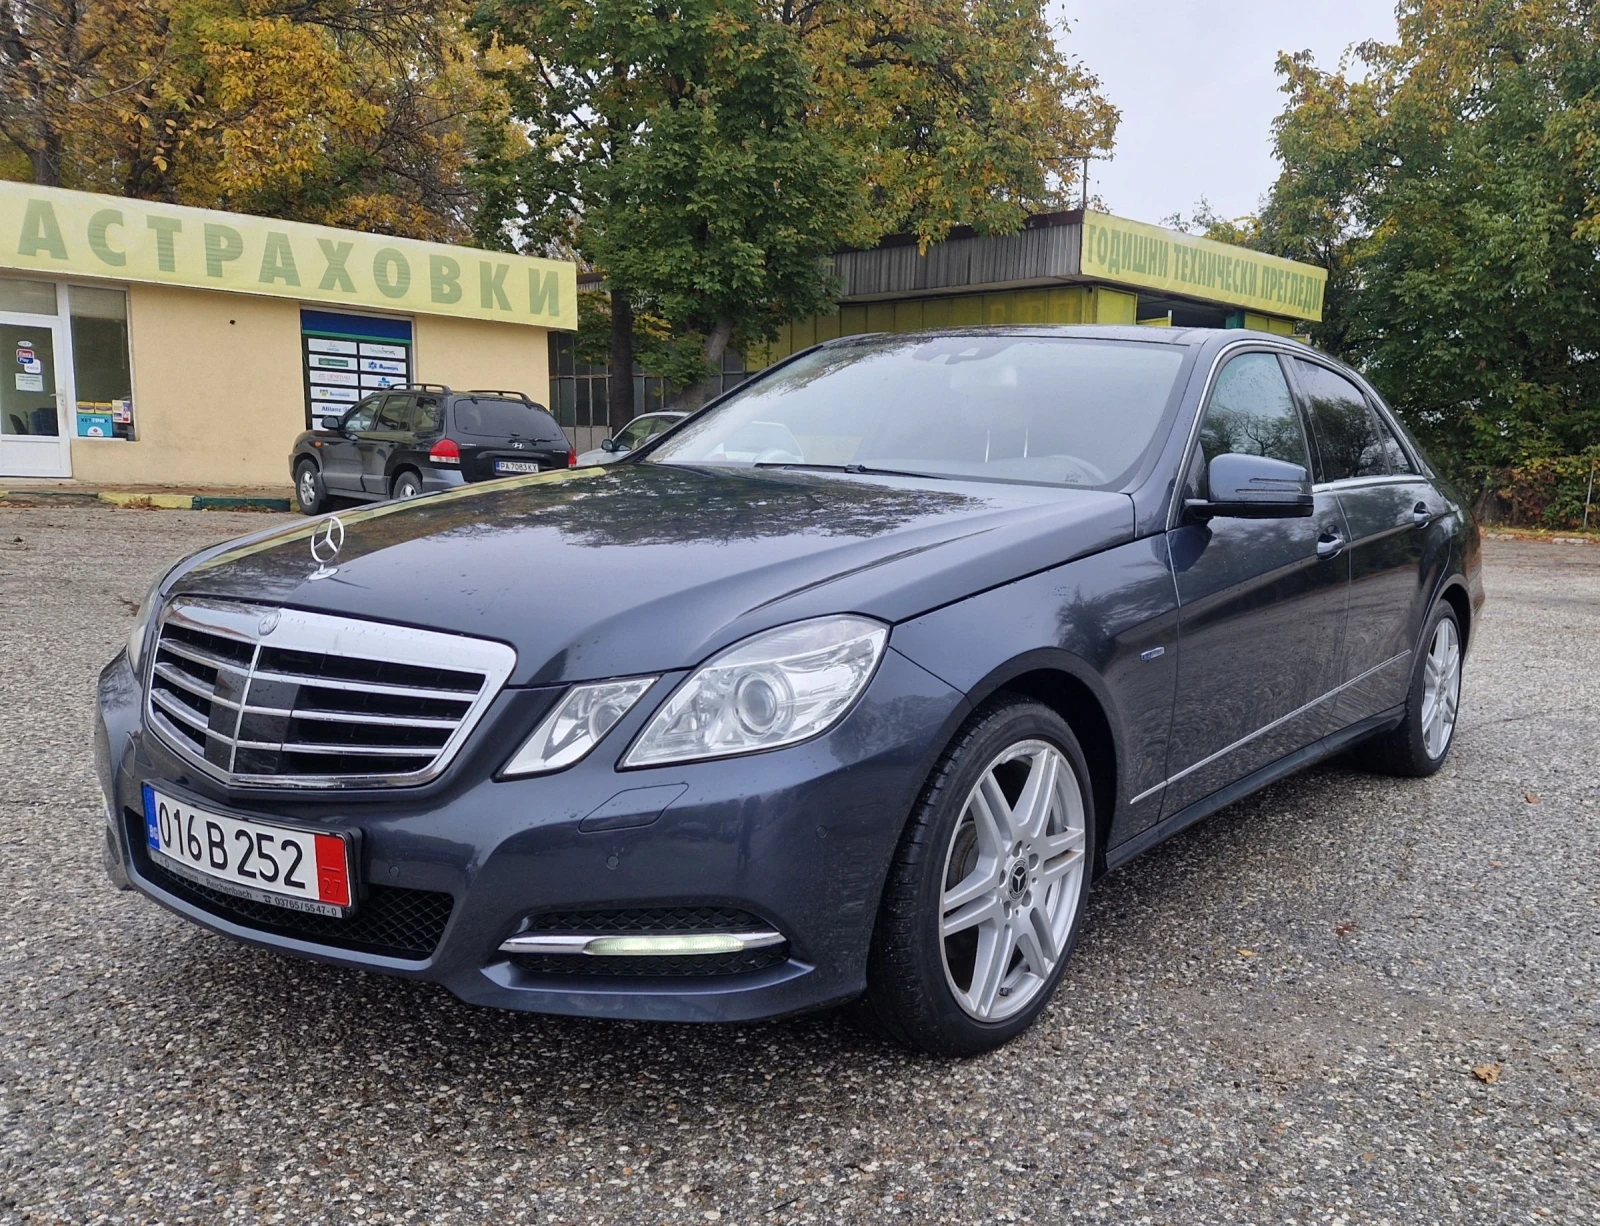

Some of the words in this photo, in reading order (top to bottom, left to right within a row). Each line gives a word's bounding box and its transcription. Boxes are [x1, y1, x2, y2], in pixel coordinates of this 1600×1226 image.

[18, 199, 560, 318] АСТРАХОВКИ
[1087, 224, 1169, 278] ГОДИШНИ
[1173, 243, 1257, 297] ТЕХНИЧЕСКИ
[1260, 266, 1322, 315] ПРЕГЛЕДИ
[149, 824, 159, 841] BG
[206, 878, 253, 899] Reichenbach
